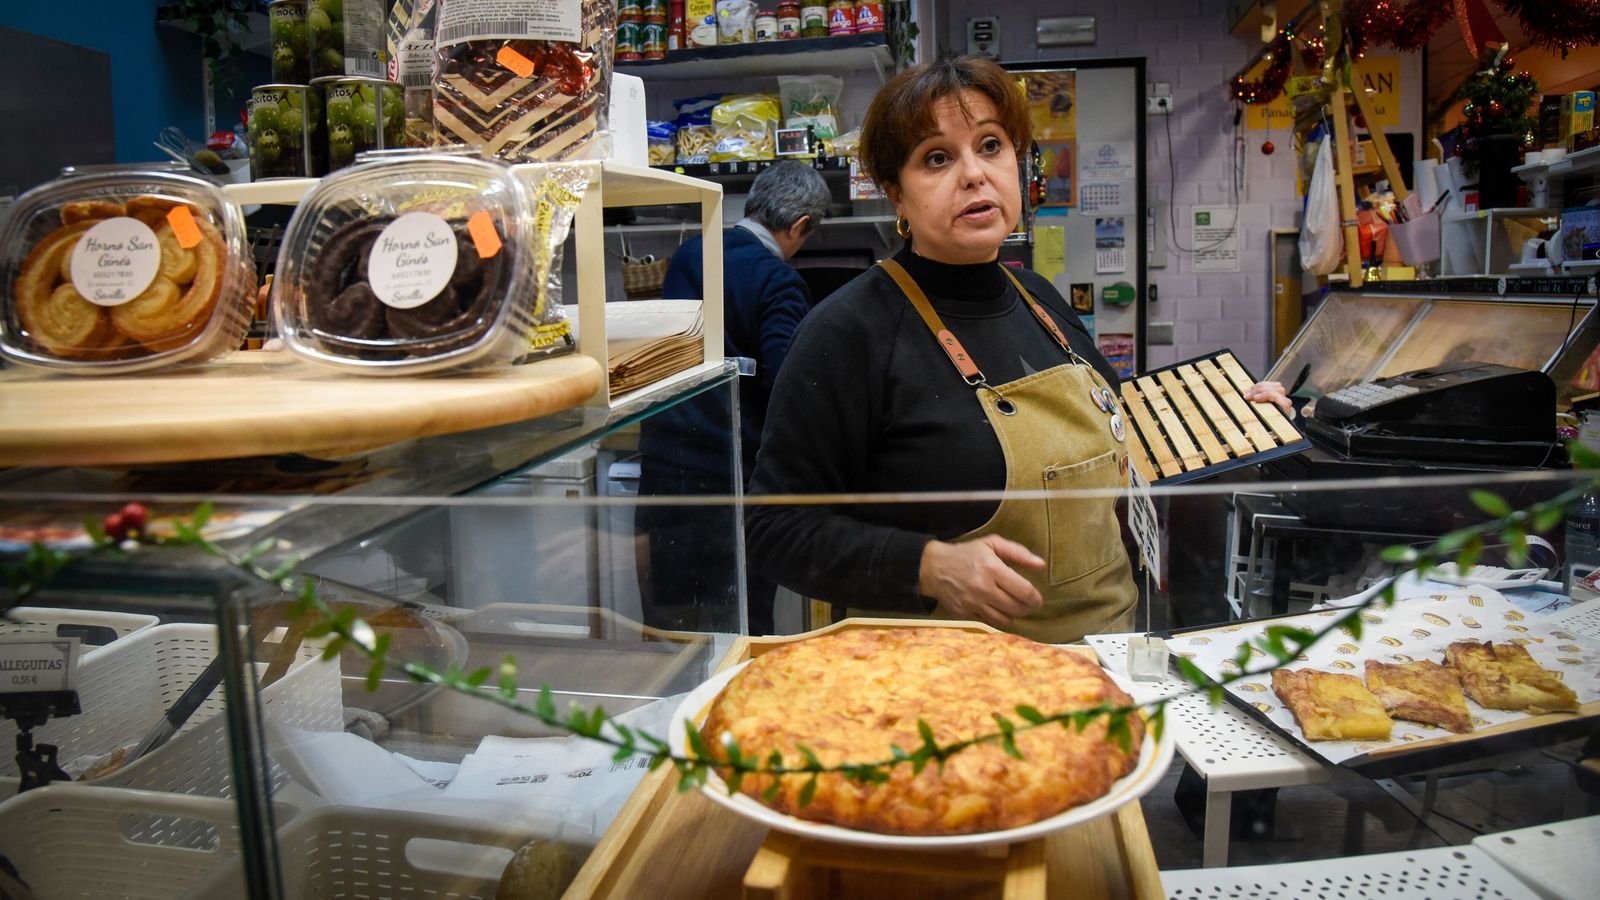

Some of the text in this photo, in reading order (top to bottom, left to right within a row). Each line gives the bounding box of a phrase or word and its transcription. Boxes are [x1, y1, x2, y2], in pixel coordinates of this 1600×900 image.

[1360, 72, 1393, 94] AN
[85, 236, 153, 253] Horno San
[382, 232, 450, 253] Horno San
[97, 253, 131, 267] Ginés
[395, 253, 429, 268] Ginés
[12, 675, 38, 686] 0,55 €
[567, 768, 592, 780] 70%
